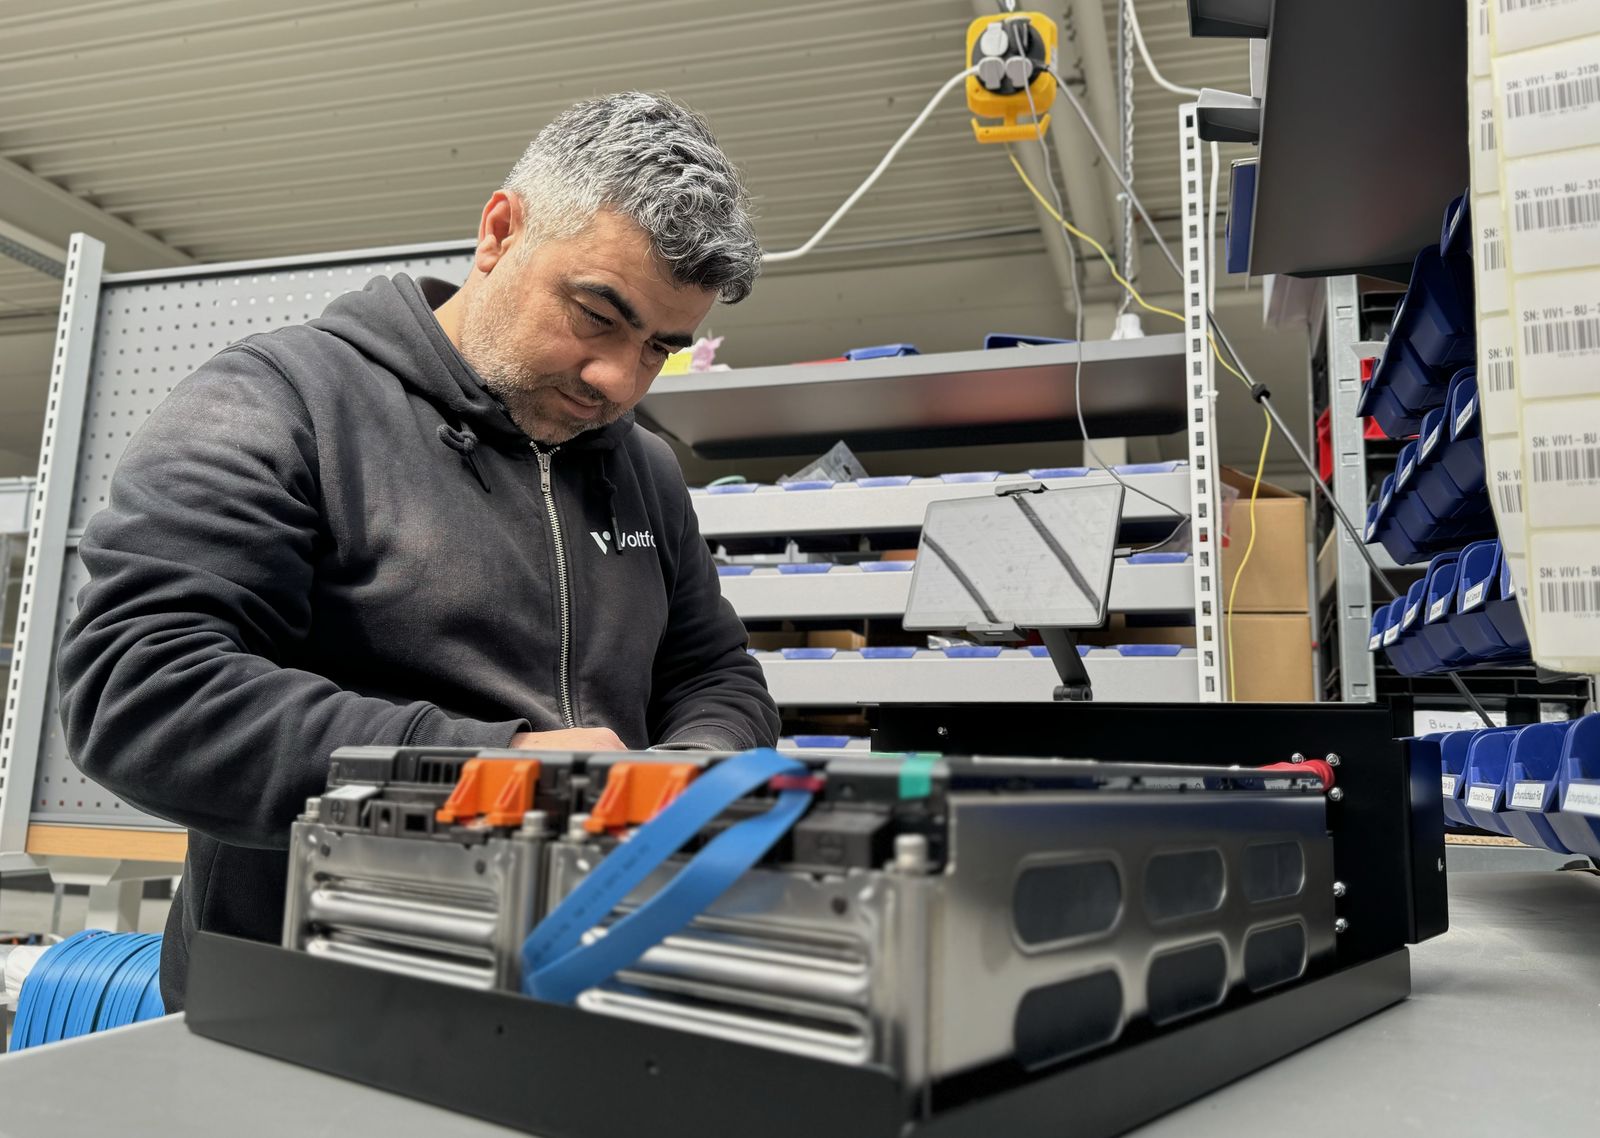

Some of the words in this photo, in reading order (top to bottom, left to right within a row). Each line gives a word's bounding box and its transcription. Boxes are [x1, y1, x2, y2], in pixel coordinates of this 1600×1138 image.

[1515, 189, 1531, 201] SN:
[1523, 310, 1540, 322] SN:
[1488, 346, 1503, 360] SN:
[1532, 435, 1549, 448] SN:
[1497, 469, 1511, 482] SN:
[1539, 566, 1557, 579] SN:
